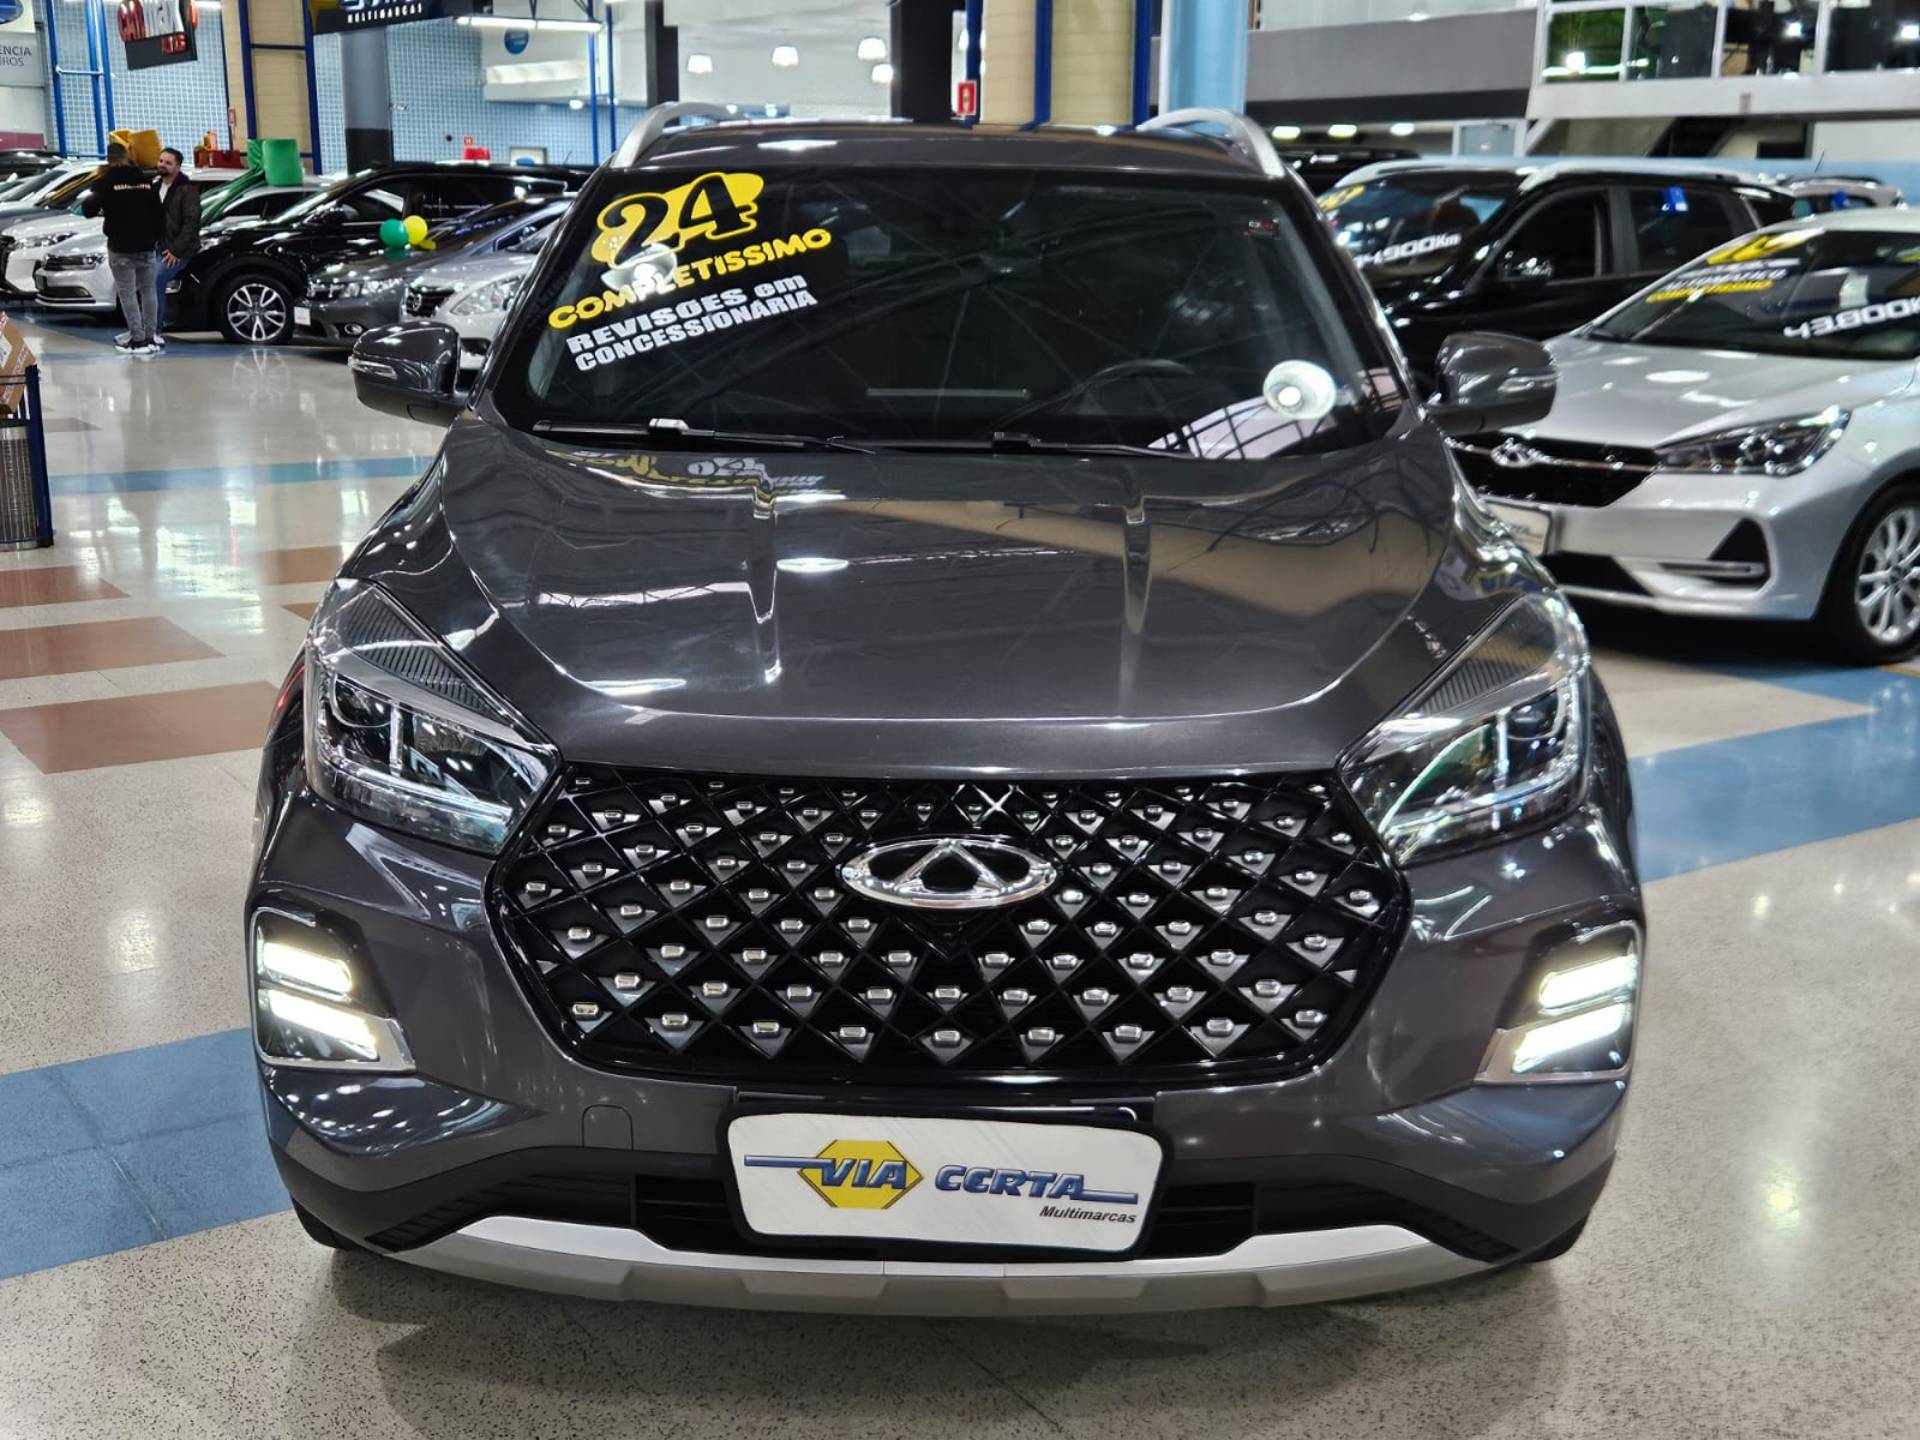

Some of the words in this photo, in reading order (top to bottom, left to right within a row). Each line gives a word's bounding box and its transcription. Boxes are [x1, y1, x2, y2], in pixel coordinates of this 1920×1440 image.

[597, 172, 760, 270] 24
[753, 273, 808, 299] em
[819, 1156, 909, 1191] VIA
[934, 1163, 1086, 1201] CERTA
[1039, 1204, 1138, 1225] Multimarcas
